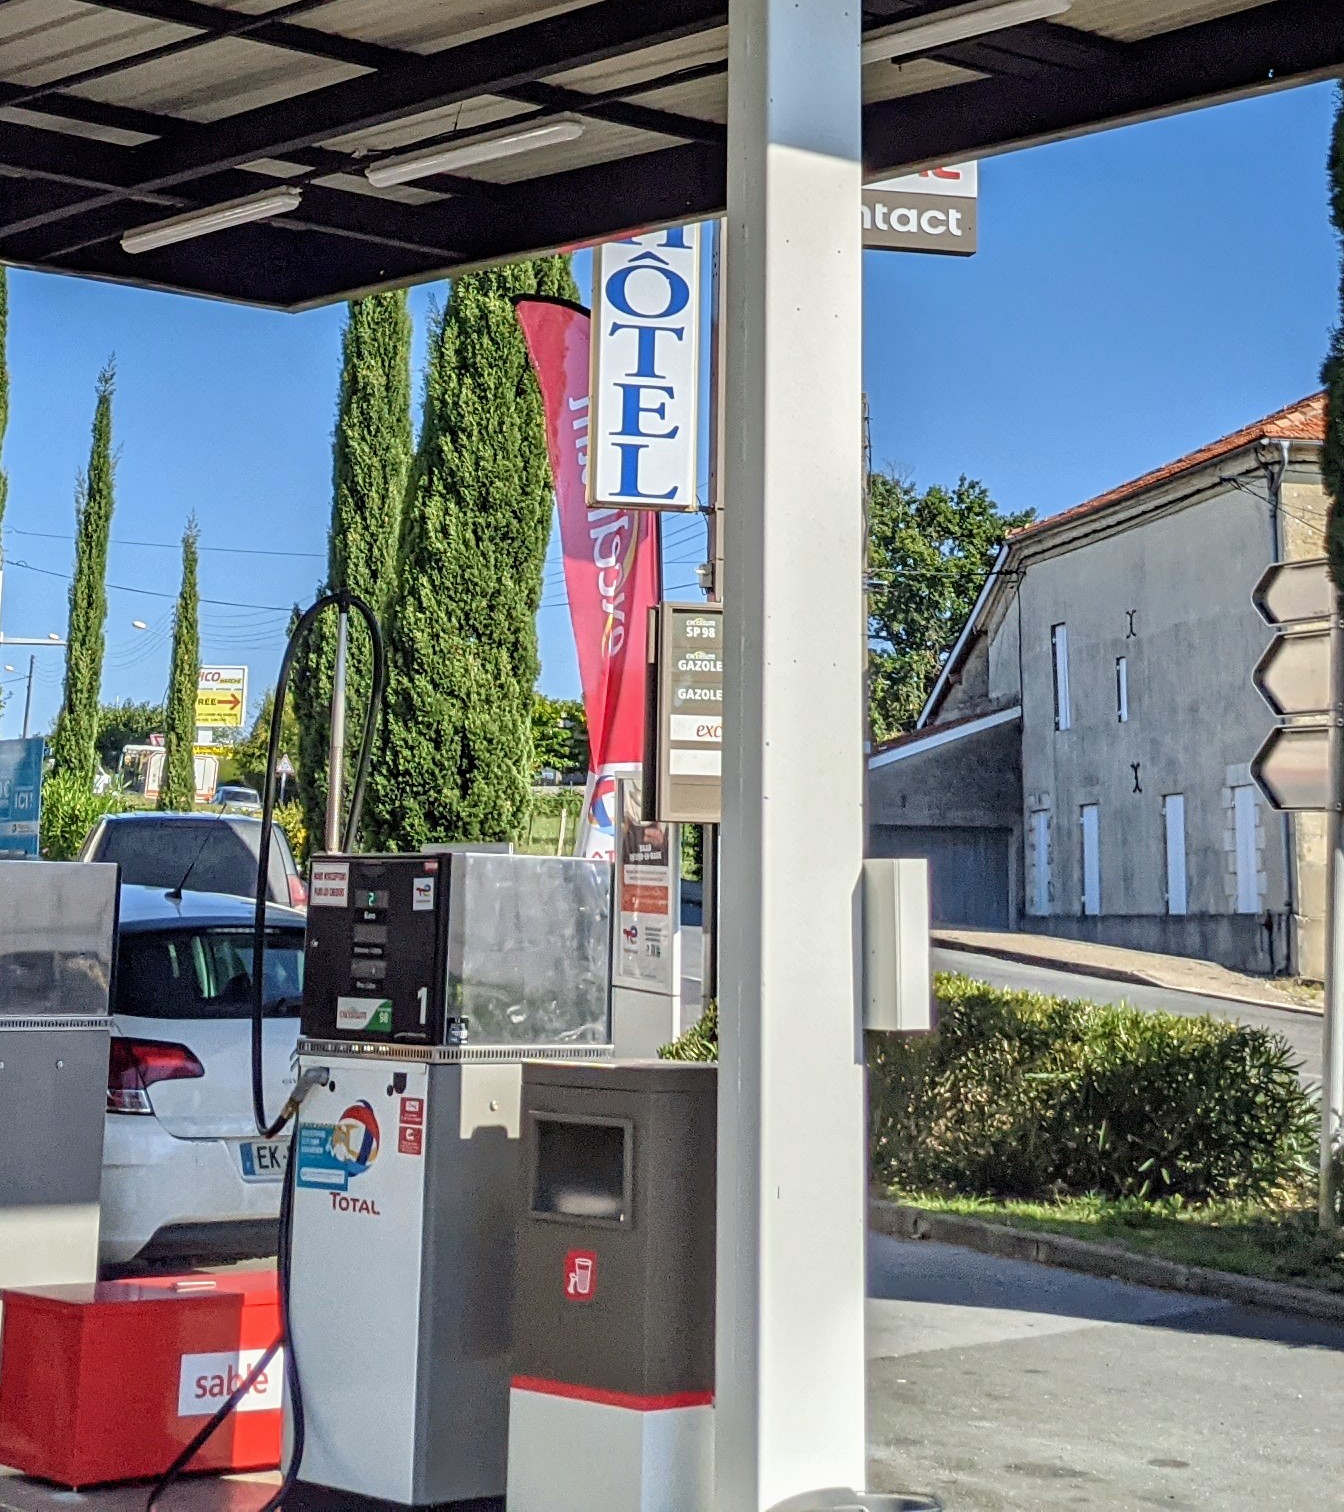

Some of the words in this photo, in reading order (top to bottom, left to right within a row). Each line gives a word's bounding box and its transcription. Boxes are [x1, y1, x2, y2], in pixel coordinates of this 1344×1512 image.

[686, 626, 701, 638] SP
[702, 627, 716, 638] 98
[677, 659, 723, 672] GAZOLE
[677, 688, 723, 701] GAZOLE
[417, 986, 428, 1025] 1
[256, 1144, 290, 1170] EK-
[329, 1191, 381, 1216] TOTAL
